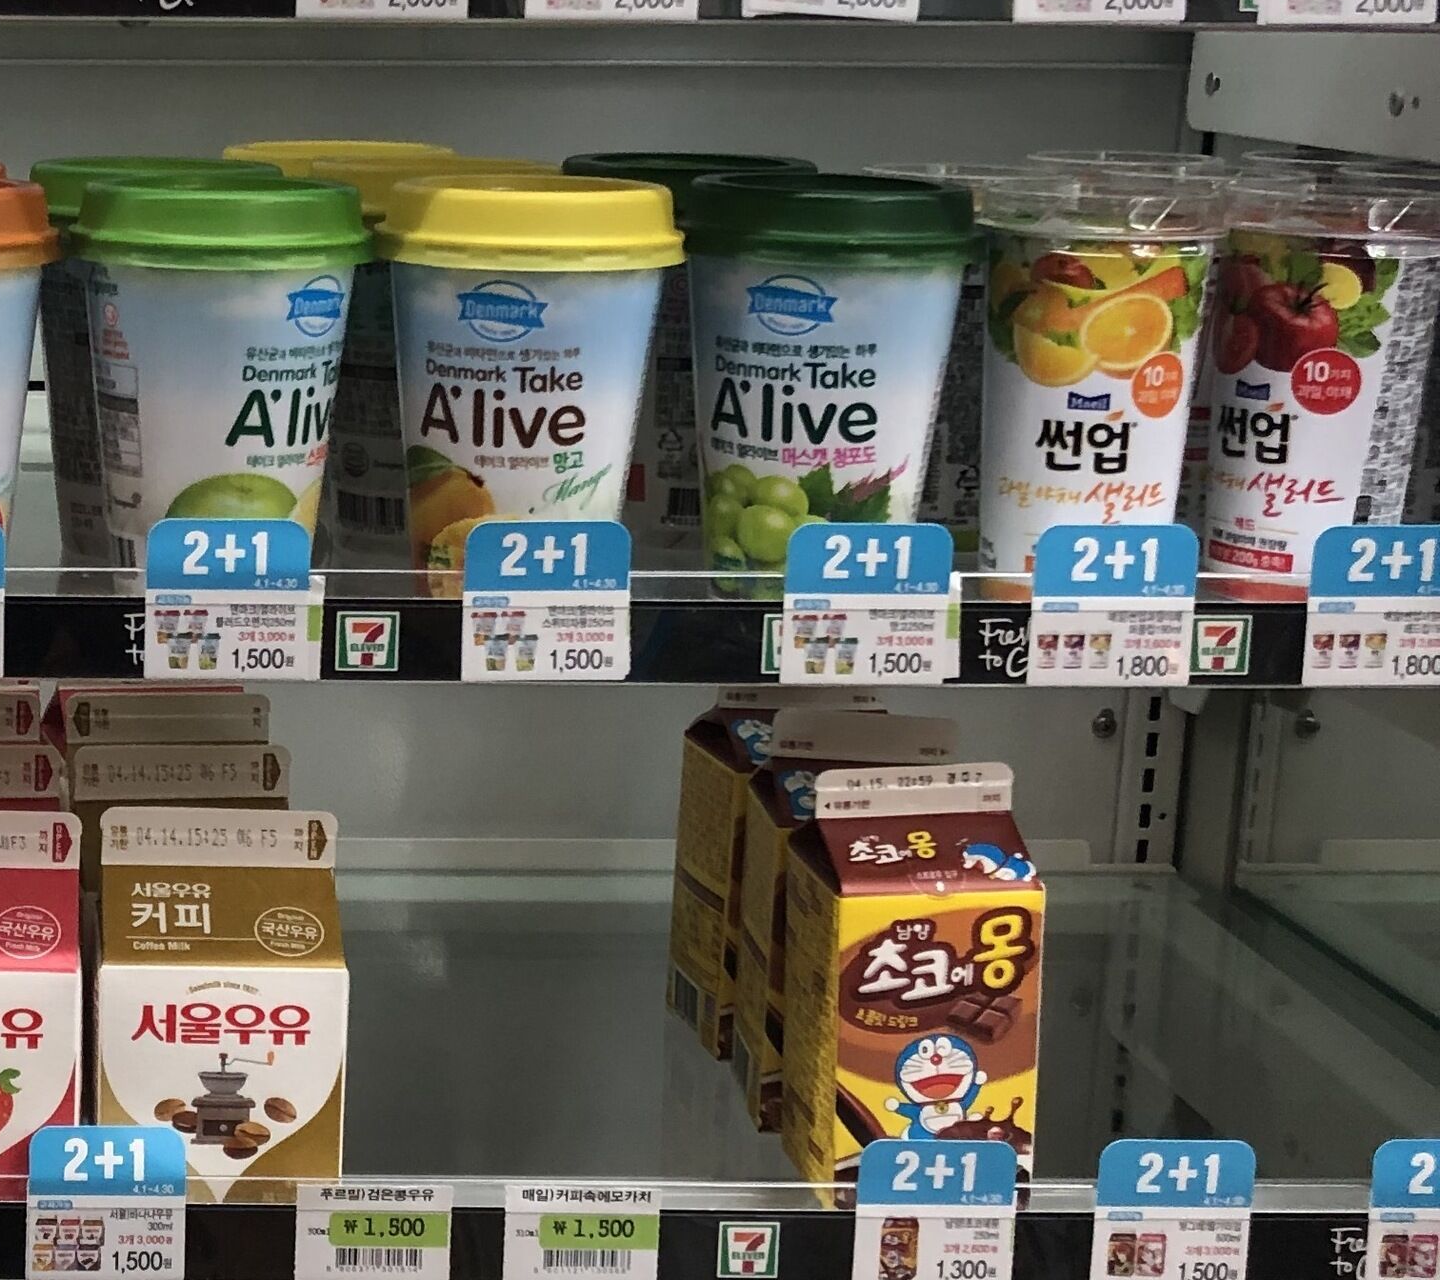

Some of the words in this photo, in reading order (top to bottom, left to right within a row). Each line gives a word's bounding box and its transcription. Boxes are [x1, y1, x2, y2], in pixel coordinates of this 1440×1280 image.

[553, 452, 583, 472] 망고
[1035, 420, 1131, 474] 썬업
[823, 536, 912, 581] 2+1
[1071, 537, 1159, 582] 2+1
[131, 901, 211, 935] 커피
[63, 1138, 147, 1182] 2+1
[320, 1186, 435, 1201] 푸르밀)검은콩우유
